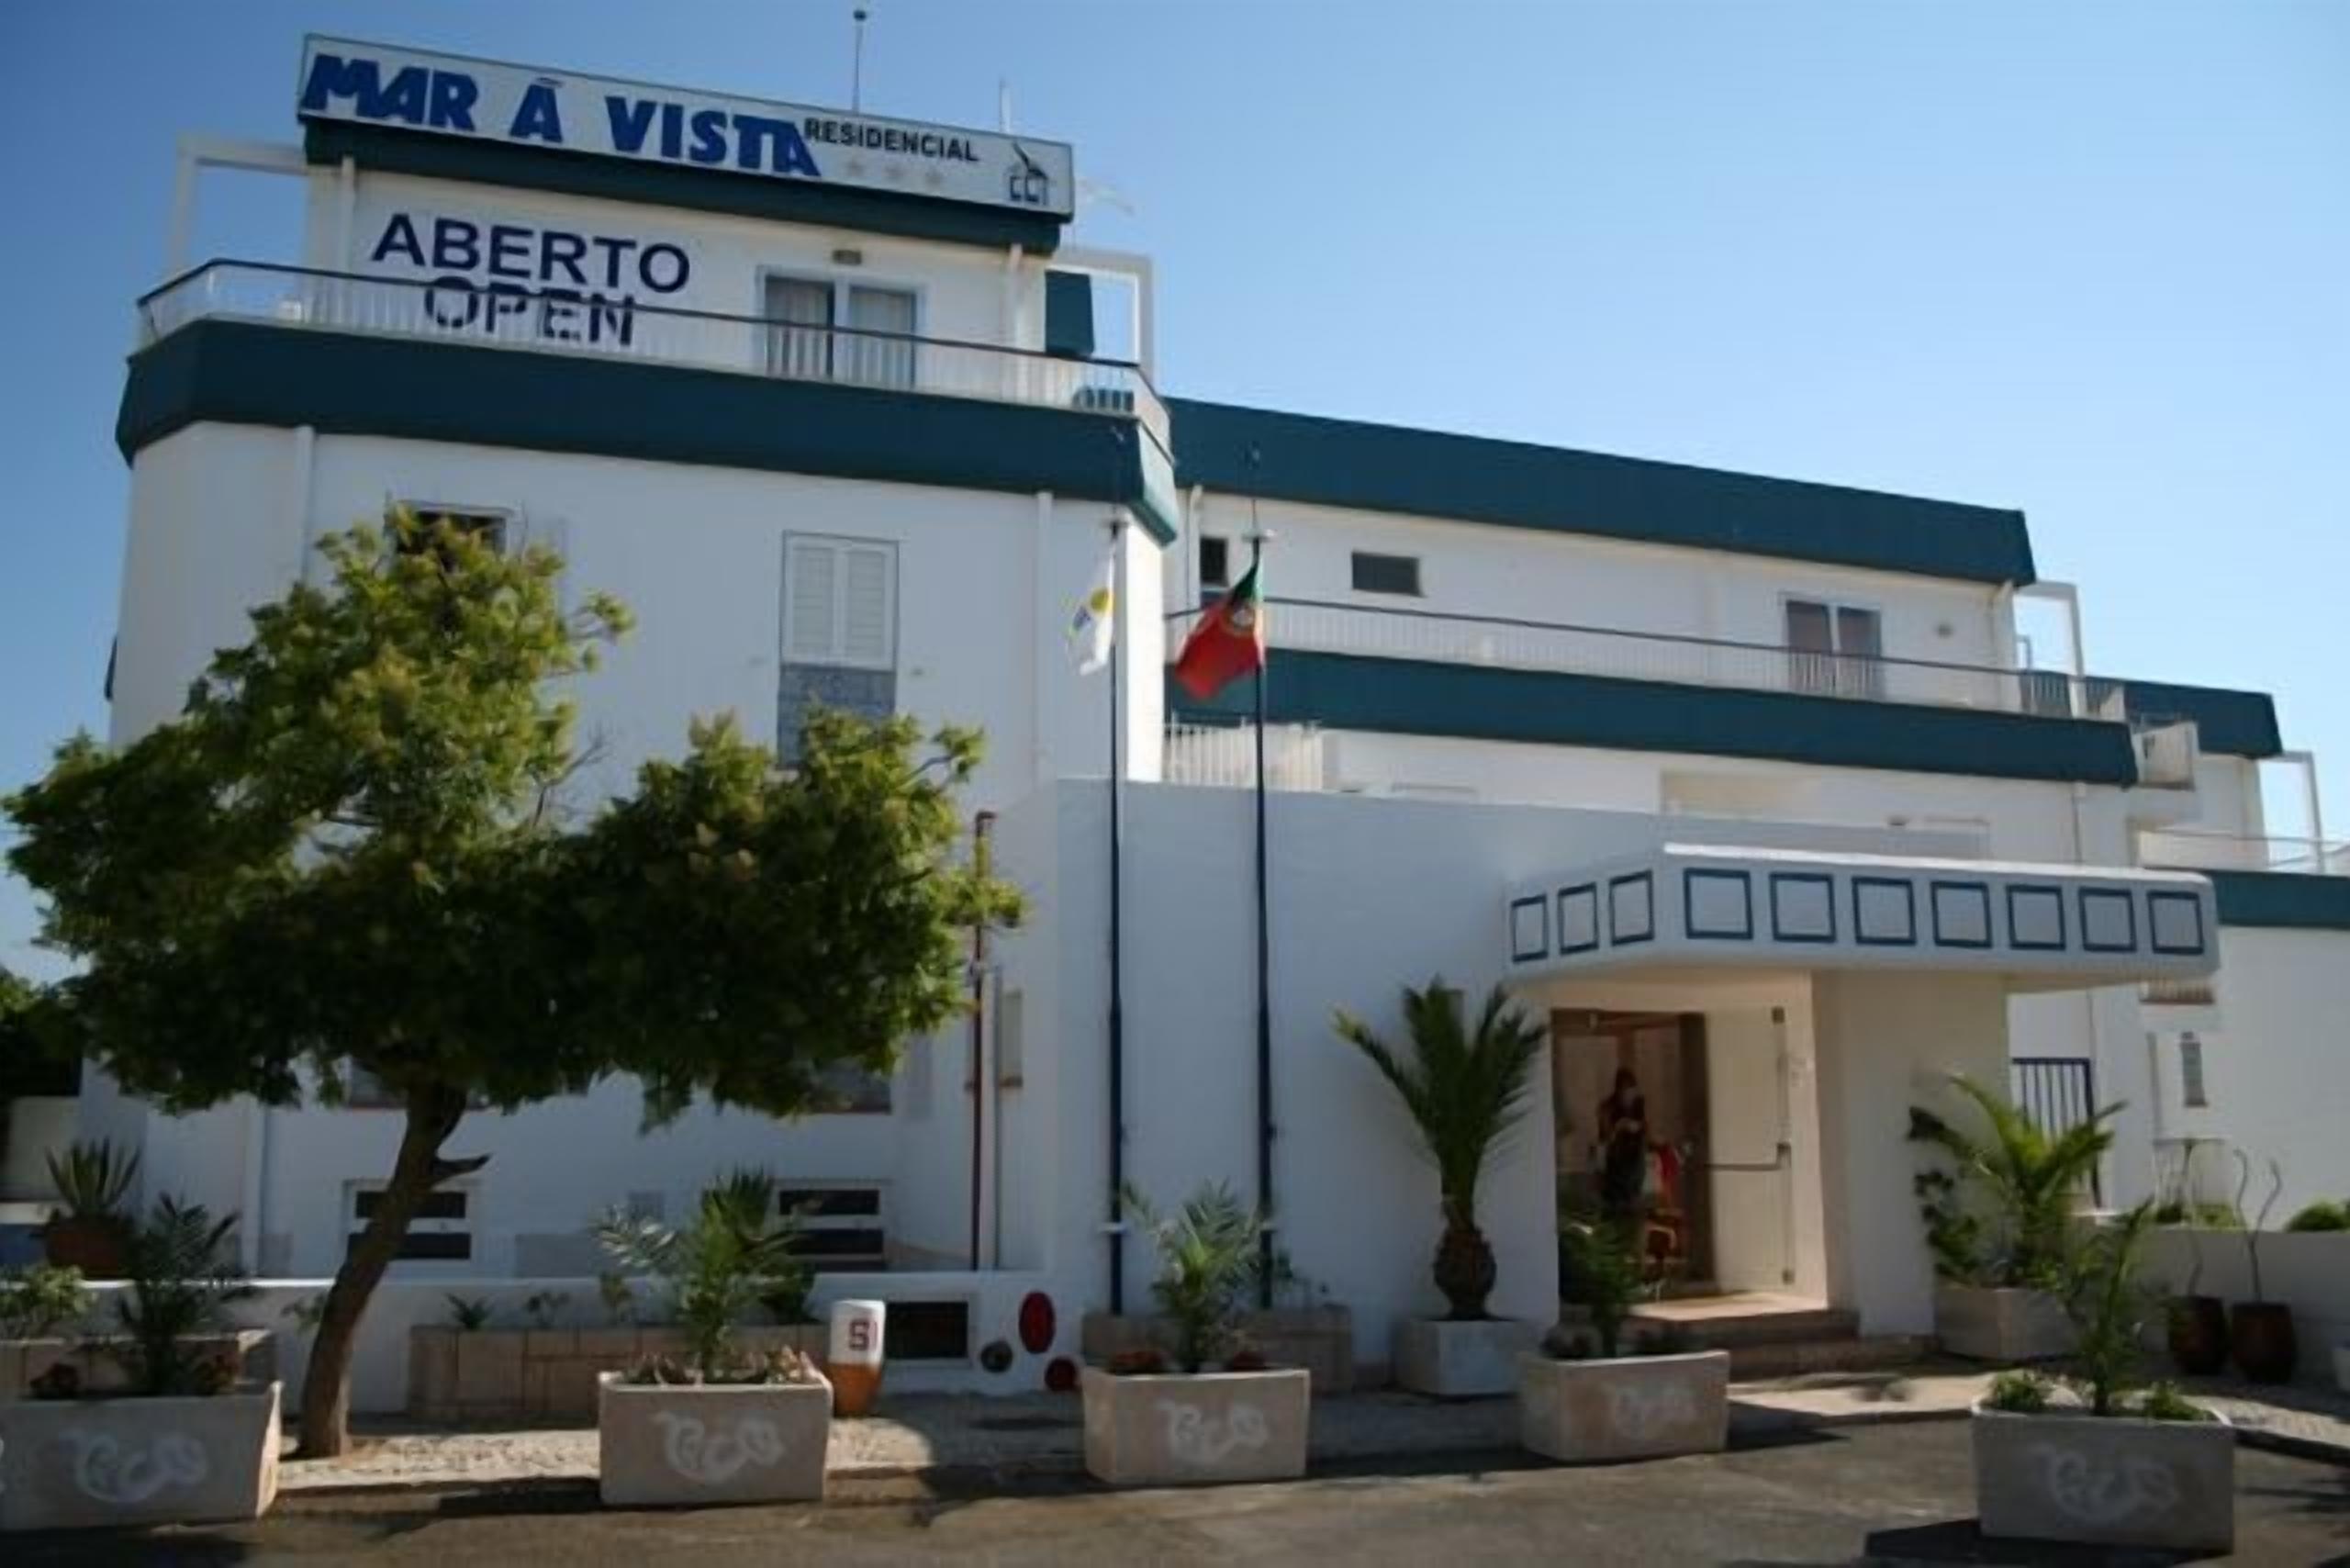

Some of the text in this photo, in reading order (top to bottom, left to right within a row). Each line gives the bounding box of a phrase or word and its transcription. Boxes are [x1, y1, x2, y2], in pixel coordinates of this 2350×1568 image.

[299, 53, 478, 132] MAR
[604, 95, 822, 178] VISTA
[803, 117, 979, 162] RESIDENCIAL
[371, 213, 690, 293] ABERTO
[424, 275, 636, 347] OPEN
